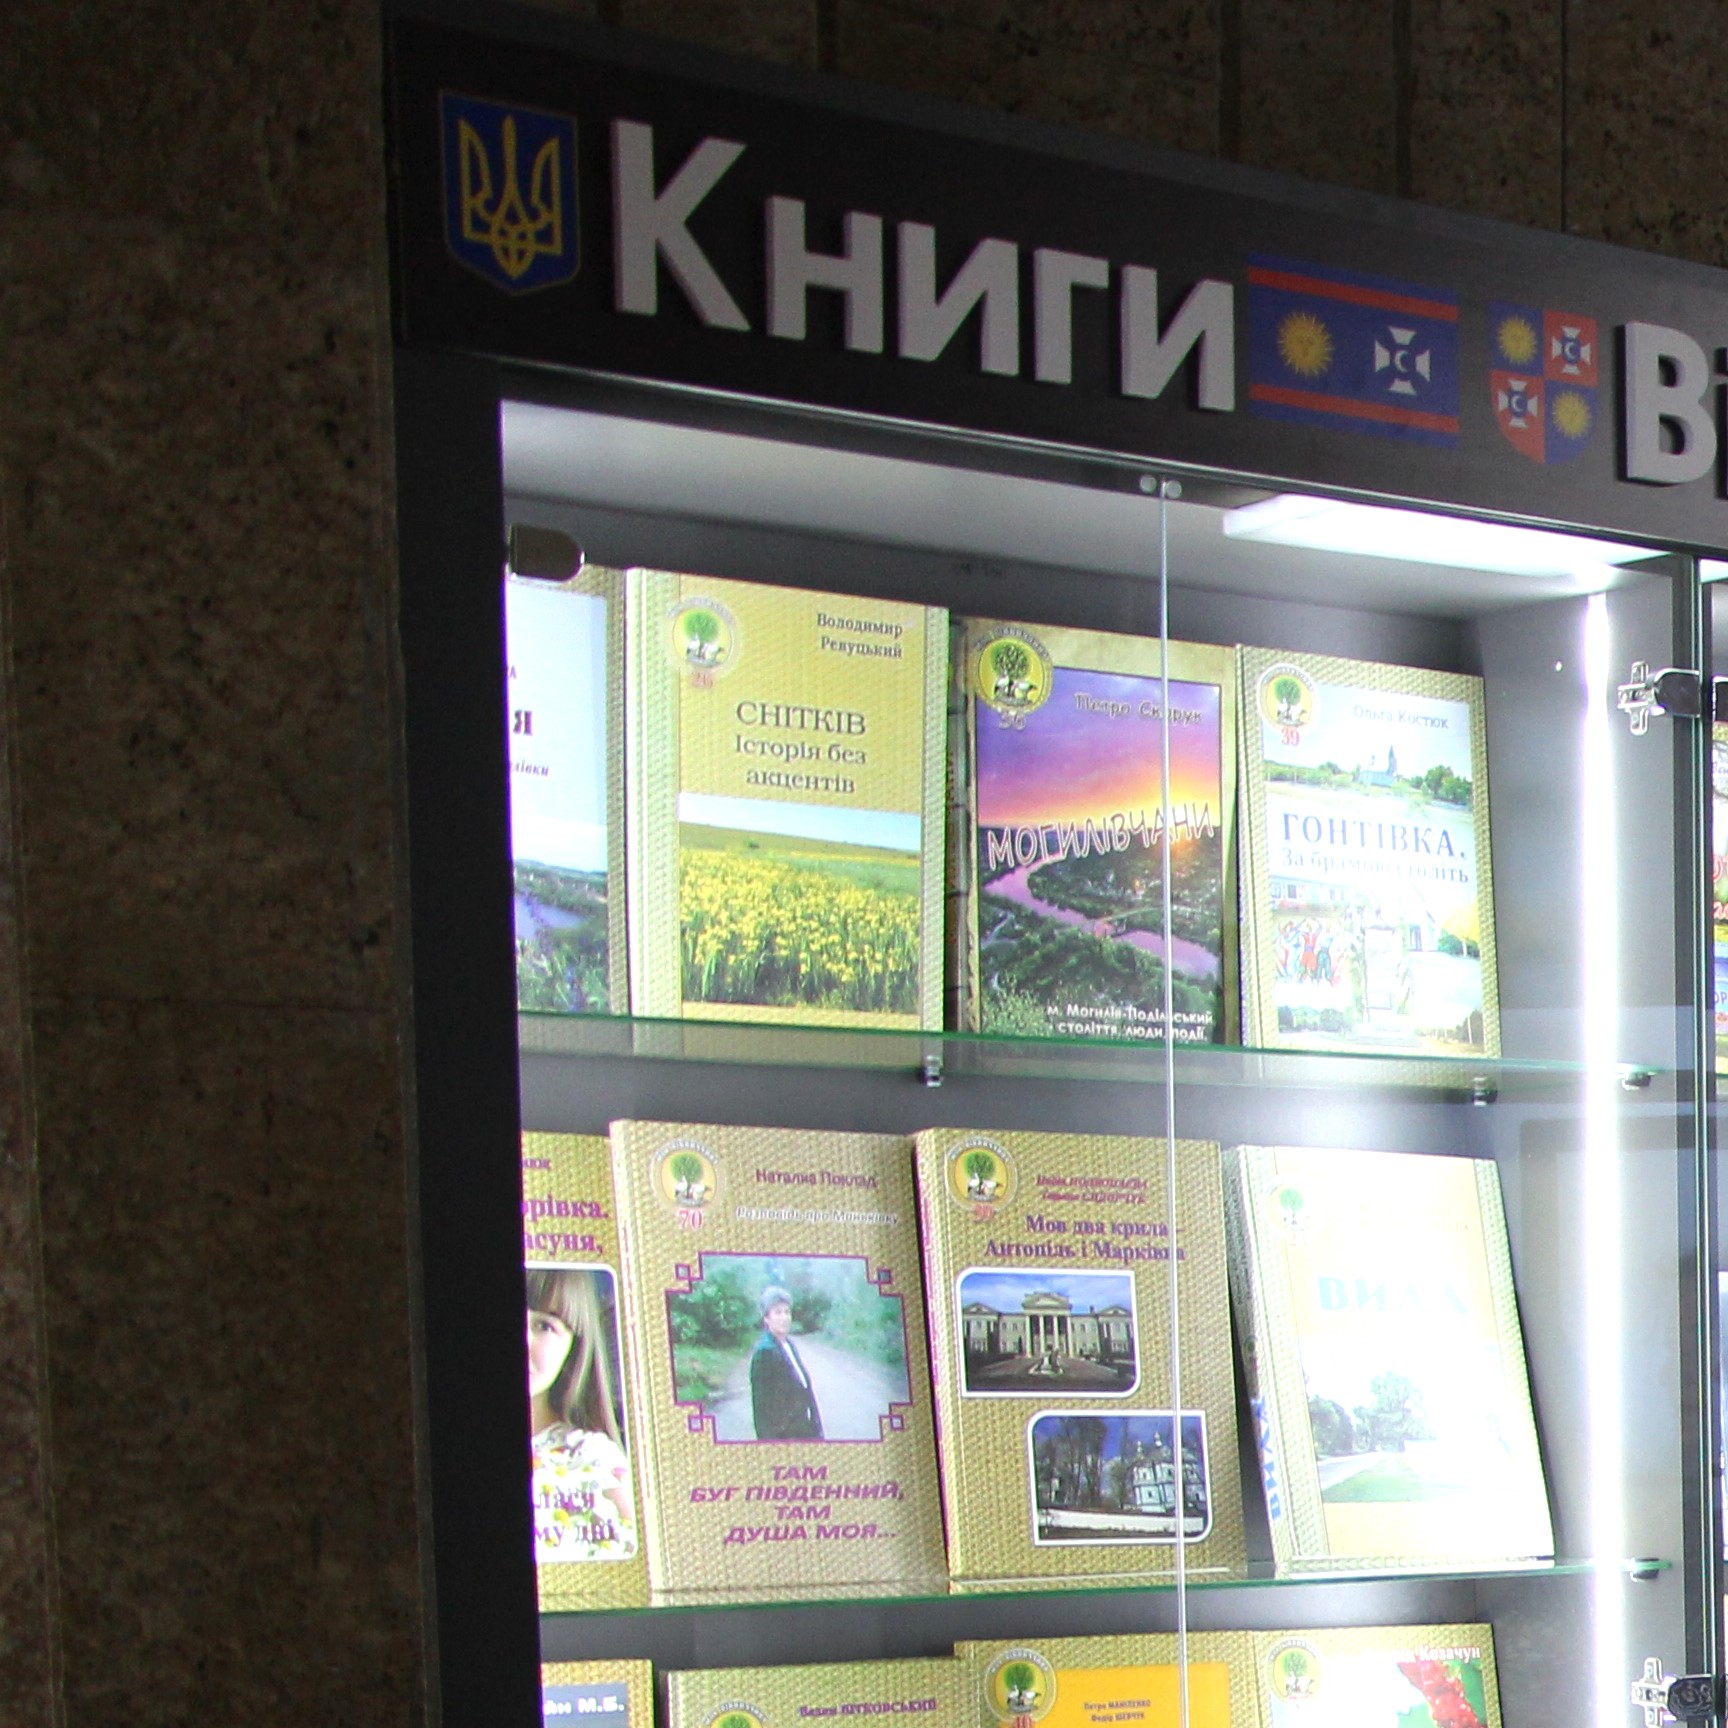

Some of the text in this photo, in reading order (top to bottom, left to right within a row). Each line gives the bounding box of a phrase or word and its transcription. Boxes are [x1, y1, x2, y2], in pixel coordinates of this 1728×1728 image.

[609, 118, 1236, 412] Книги
[816, 612, 904, 636] Володимир
[820, 635, 903, 658] Ревуцький
[1074, 691, 1132, 717] Петро
[735, 700, 867, 736] СНІТКІВ
[1398, 708, 1450, 731] Костюк
[735, 733, 867, 767] Історія без
[745, 767, 855, 794] акцентів
[987, 801, 1215, 873] МОГИЛІВЧАНИ
[1281, 811, 1468, 862] ГОНТІВКА.
[679, 1208, 704, 1230] 70
[1026, 1214, 1067, 1234] Мов
[1073, 1220, 1106, 1236] два
[1111, 1221, 1170, 1241] крила
[984, 1238, 1076, 1260] Антопіль
[1080, 1240, 1088, 1259] і
[770, 1464, 828, 1481] ТАМ
[690, 1482, 905, 1503] БУГ ПІВДЕННИЙ,
[776, 1504, 832, 1520] ТАМ
[723, 1523, 898, 1546] ДУША МОЯ...
